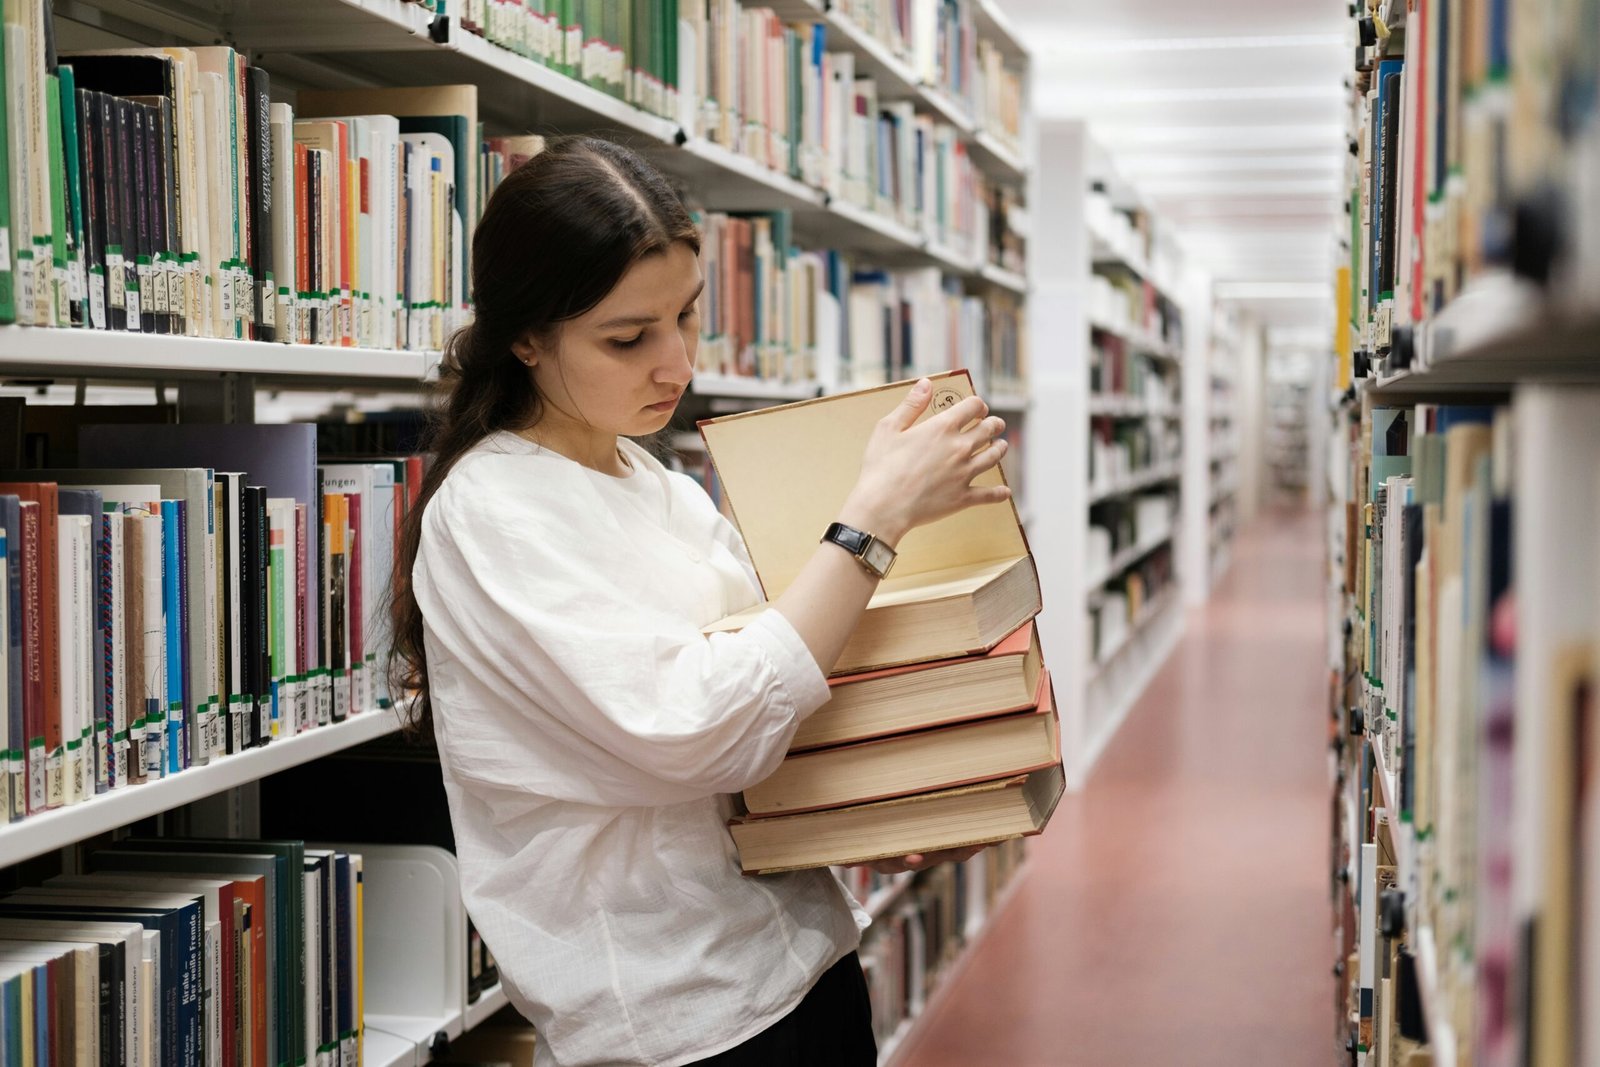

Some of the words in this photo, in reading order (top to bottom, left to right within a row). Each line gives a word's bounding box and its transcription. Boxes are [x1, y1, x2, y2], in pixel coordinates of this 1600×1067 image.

[325, 479, 356, 489] ungen
[30, 511, 40, 683] KULTURANTHROPOLOGIE
[188, 913, 197, 952] Fremde
[189, 952, 197, 982] weiße
[181, 971, 190, 1006] Kirahé
[189, 983, 197, 1002] Der
